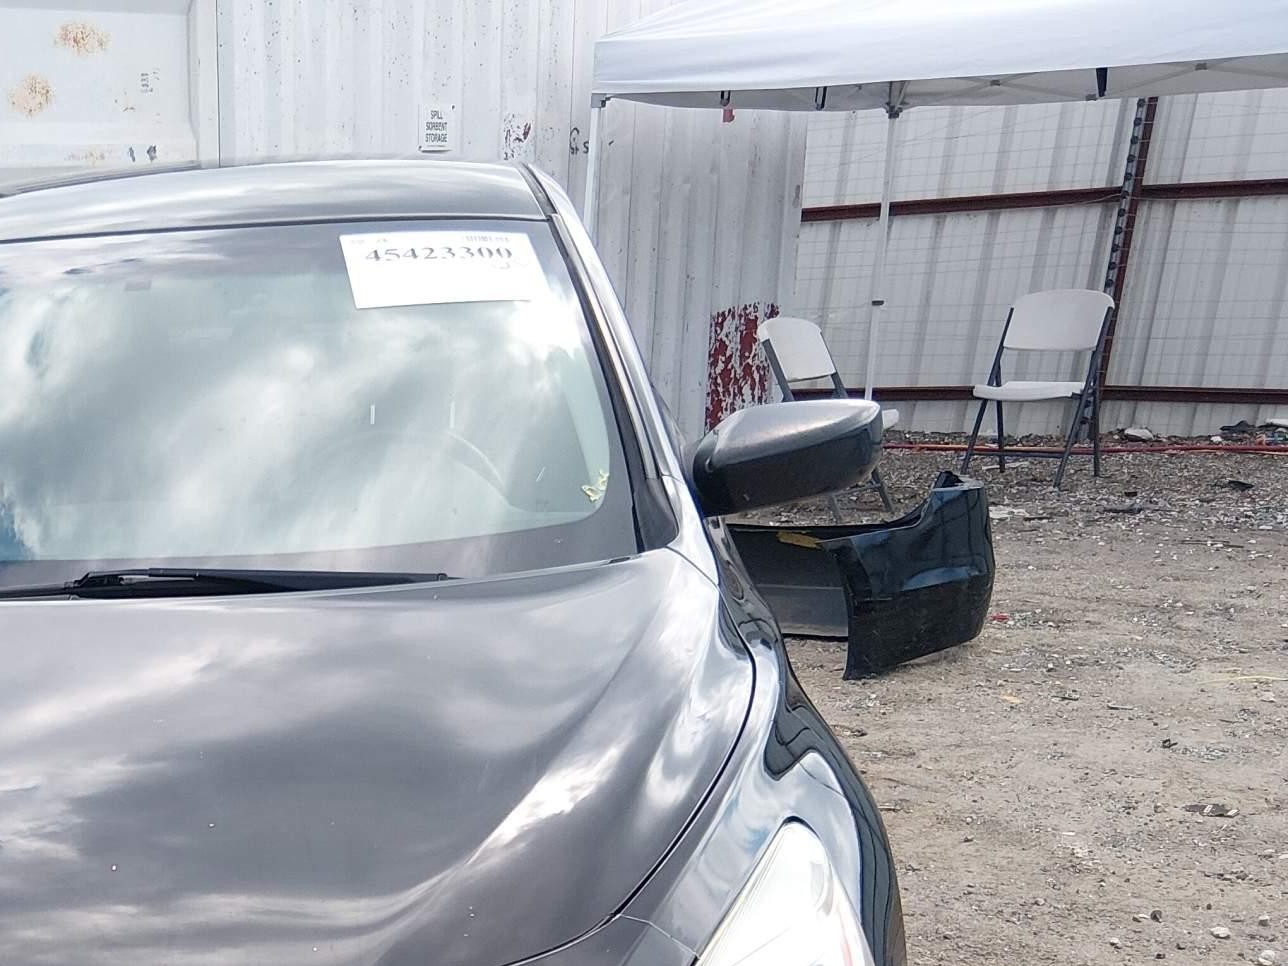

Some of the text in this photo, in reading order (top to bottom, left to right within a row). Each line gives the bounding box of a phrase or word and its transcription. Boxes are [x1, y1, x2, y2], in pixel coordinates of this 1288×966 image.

[430, 110, 443, 120] SPILL
[425, 122, 448, 131] SORBENT
[425, 133, 448, 143] STORAGE
[365, 246, 513, 262] 45423300
